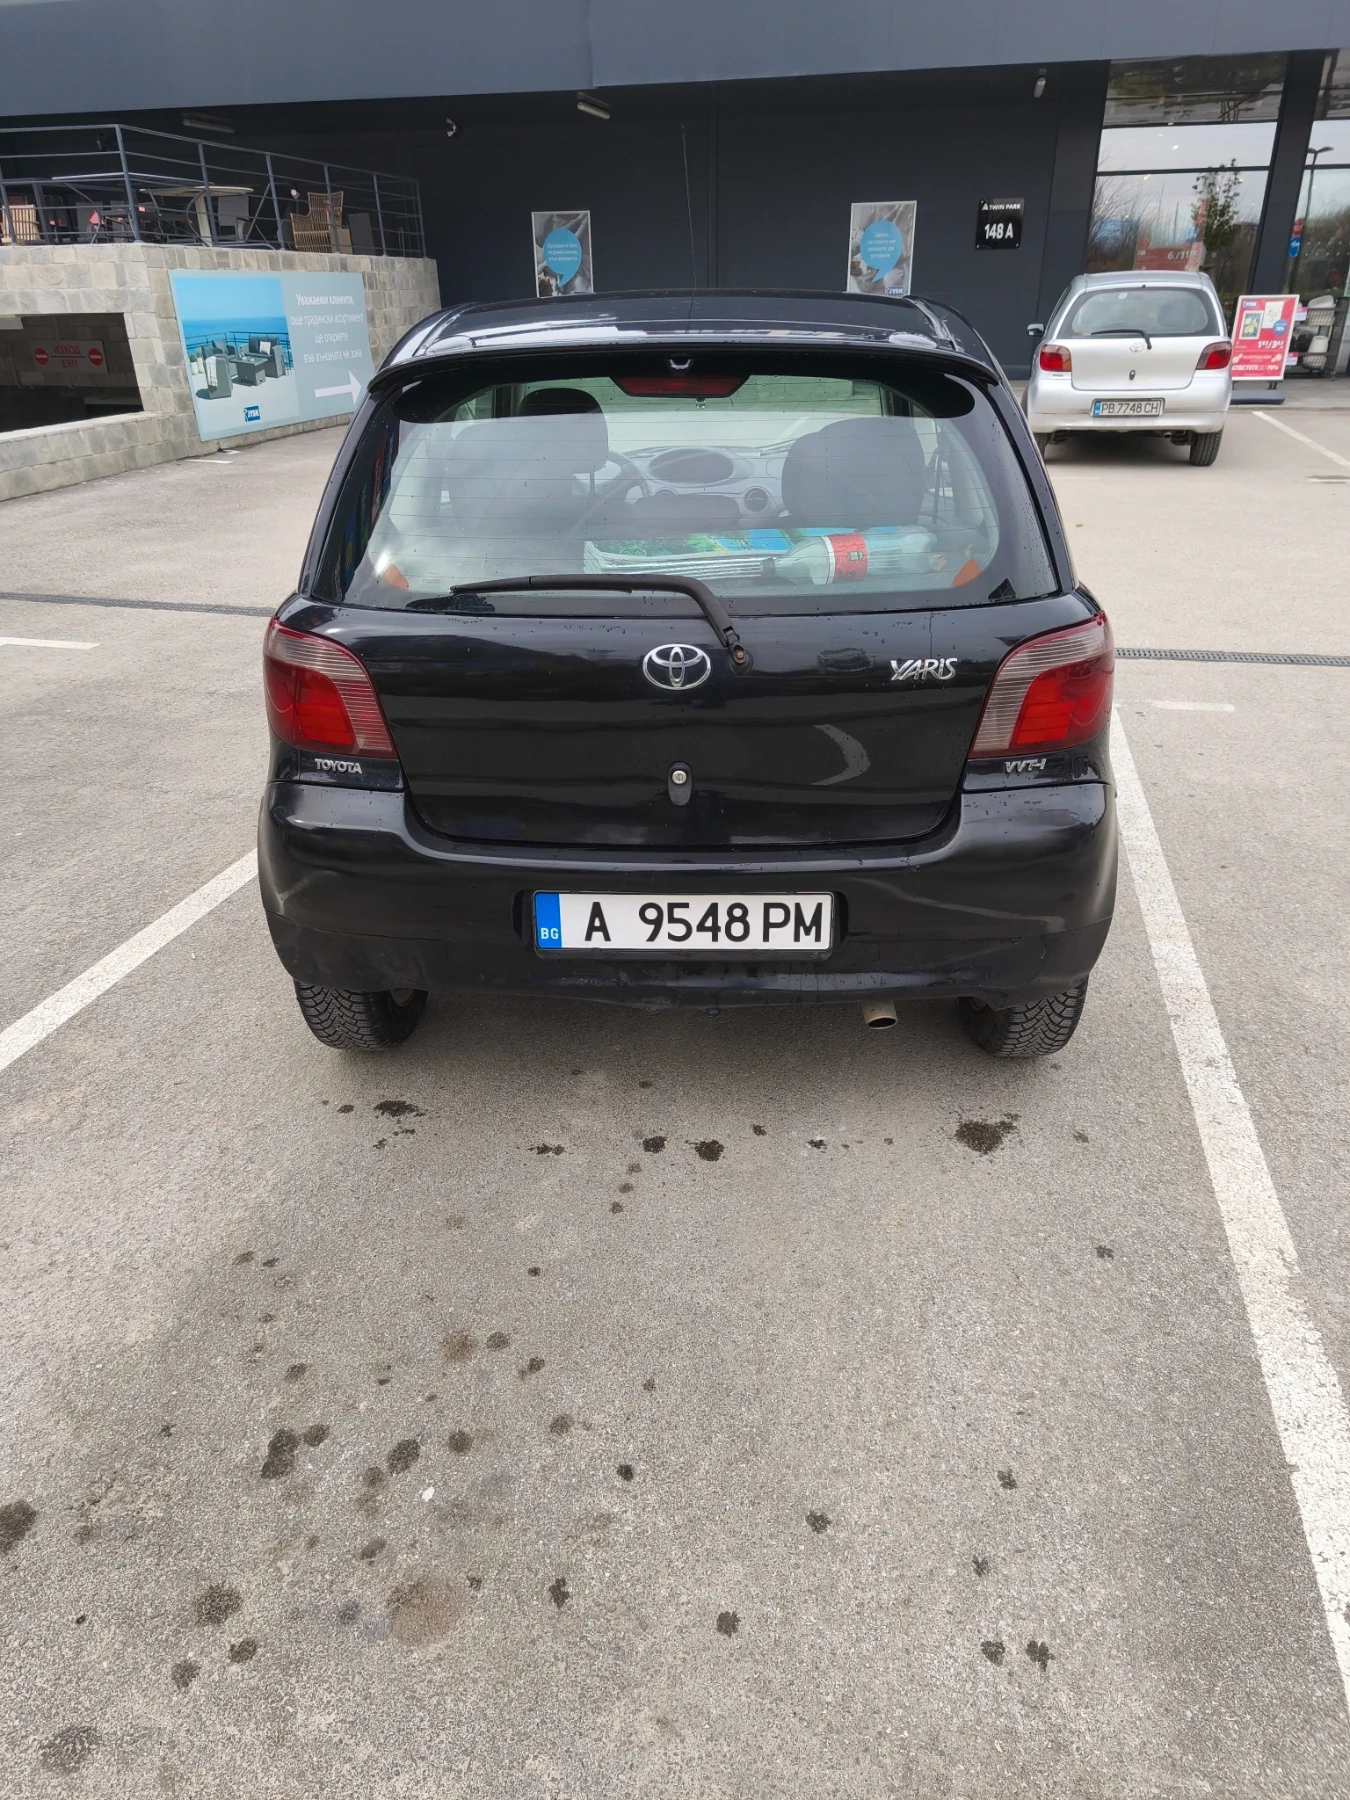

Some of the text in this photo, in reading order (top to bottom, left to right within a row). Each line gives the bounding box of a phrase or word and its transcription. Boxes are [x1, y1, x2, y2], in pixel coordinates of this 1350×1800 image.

[984, 222, 1014, 240] 148 A
[295, 293, 355, 306] Уважаеми клиенти,
[290, 313, 364, 328] още градински асортимент
[314, 333, 324, 345] ще
[53, 345, 82, 355] ИЗХОД
[61, 360, 78, 368] EXIT
[1101, 402, 1159, 414] PB 7748 CH
[314, 758, 363, 774] TOYOTA
[584, 901, 823, 942] A 9548 PM
[540, 927, 559, 940] BG
